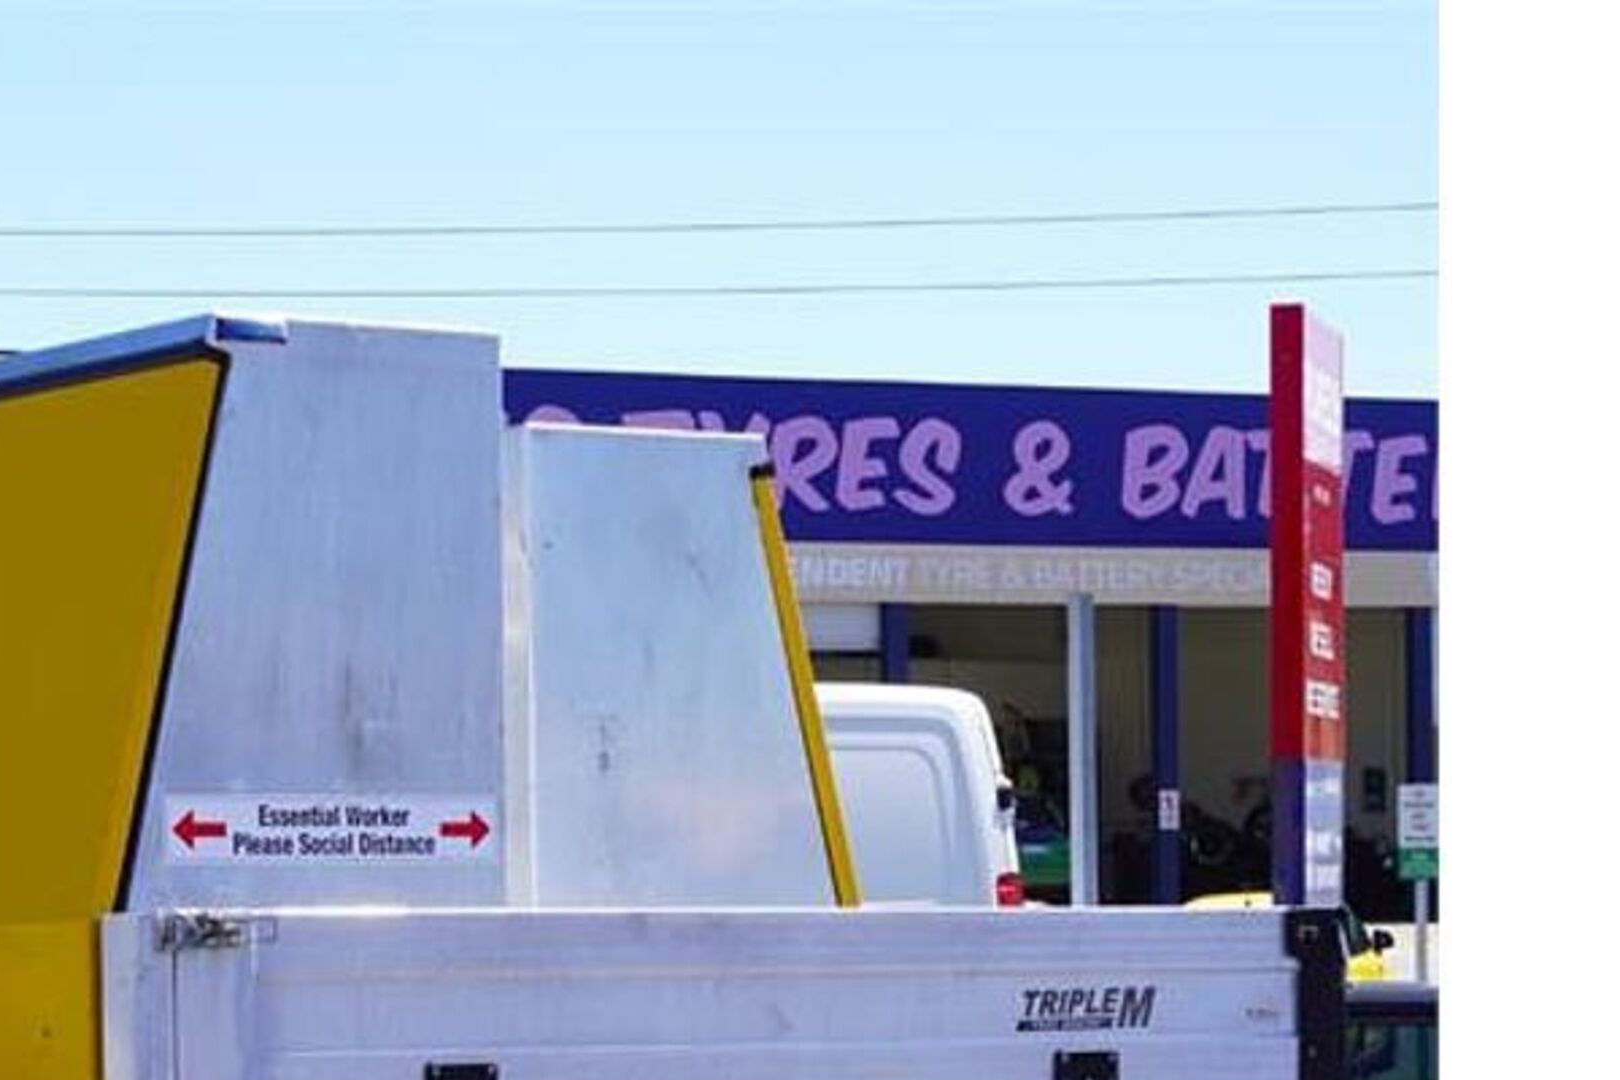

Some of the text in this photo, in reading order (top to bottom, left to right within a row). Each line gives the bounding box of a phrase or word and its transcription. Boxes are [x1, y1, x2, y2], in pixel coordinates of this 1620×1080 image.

[1003, 420, 1073, 517] &
[258, 804, 410, 828] Essential Worker
[232, 832, 436, 856] Please Social Distance
